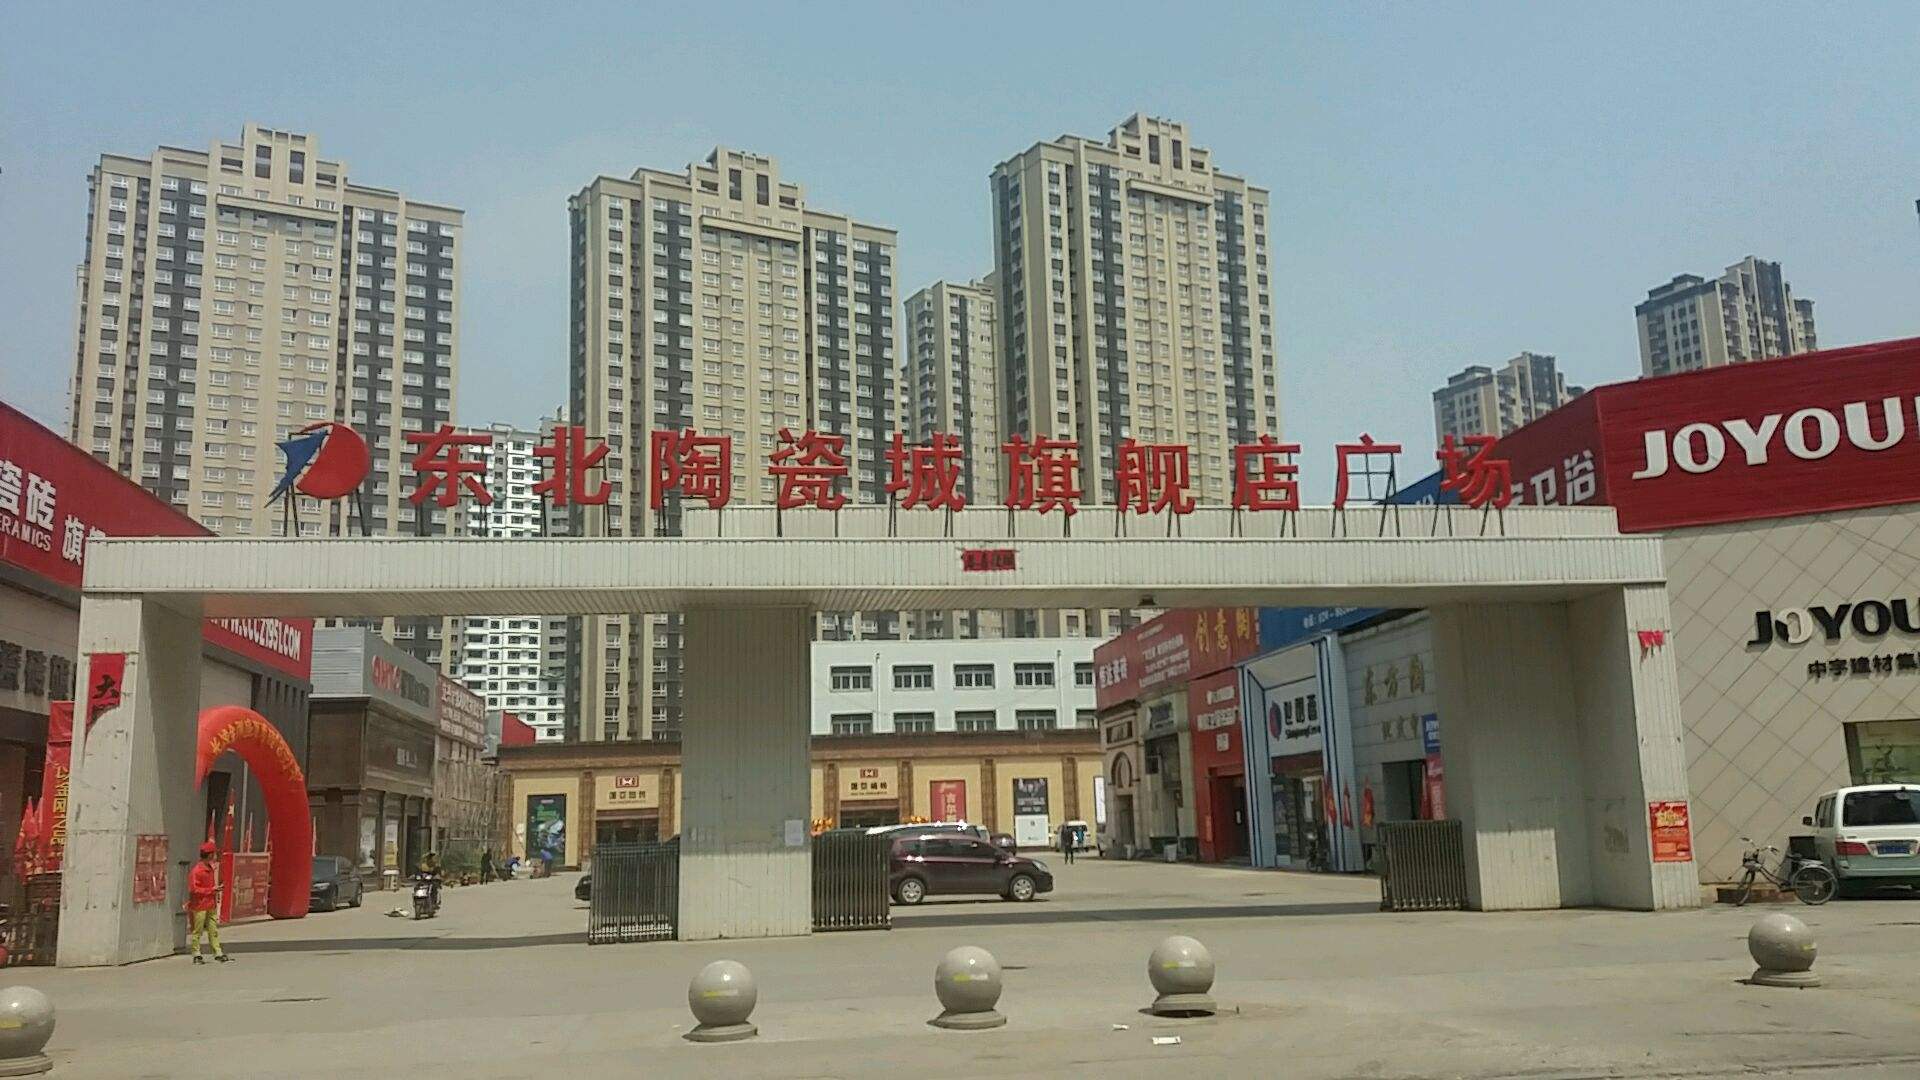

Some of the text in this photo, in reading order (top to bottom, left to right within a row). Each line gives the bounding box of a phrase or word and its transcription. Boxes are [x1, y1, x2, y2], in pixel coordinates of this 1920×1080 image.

[1632, 396, 1905, 480] JOYOU
[406, 425, 1512, 516] 东北陶瓷城旗舰店广场
[62, 514, 106, 565] 旗
[1747, 597, 1920, 645] JOYOU
[1808, 652, 1920, 678] 中宇建材集
